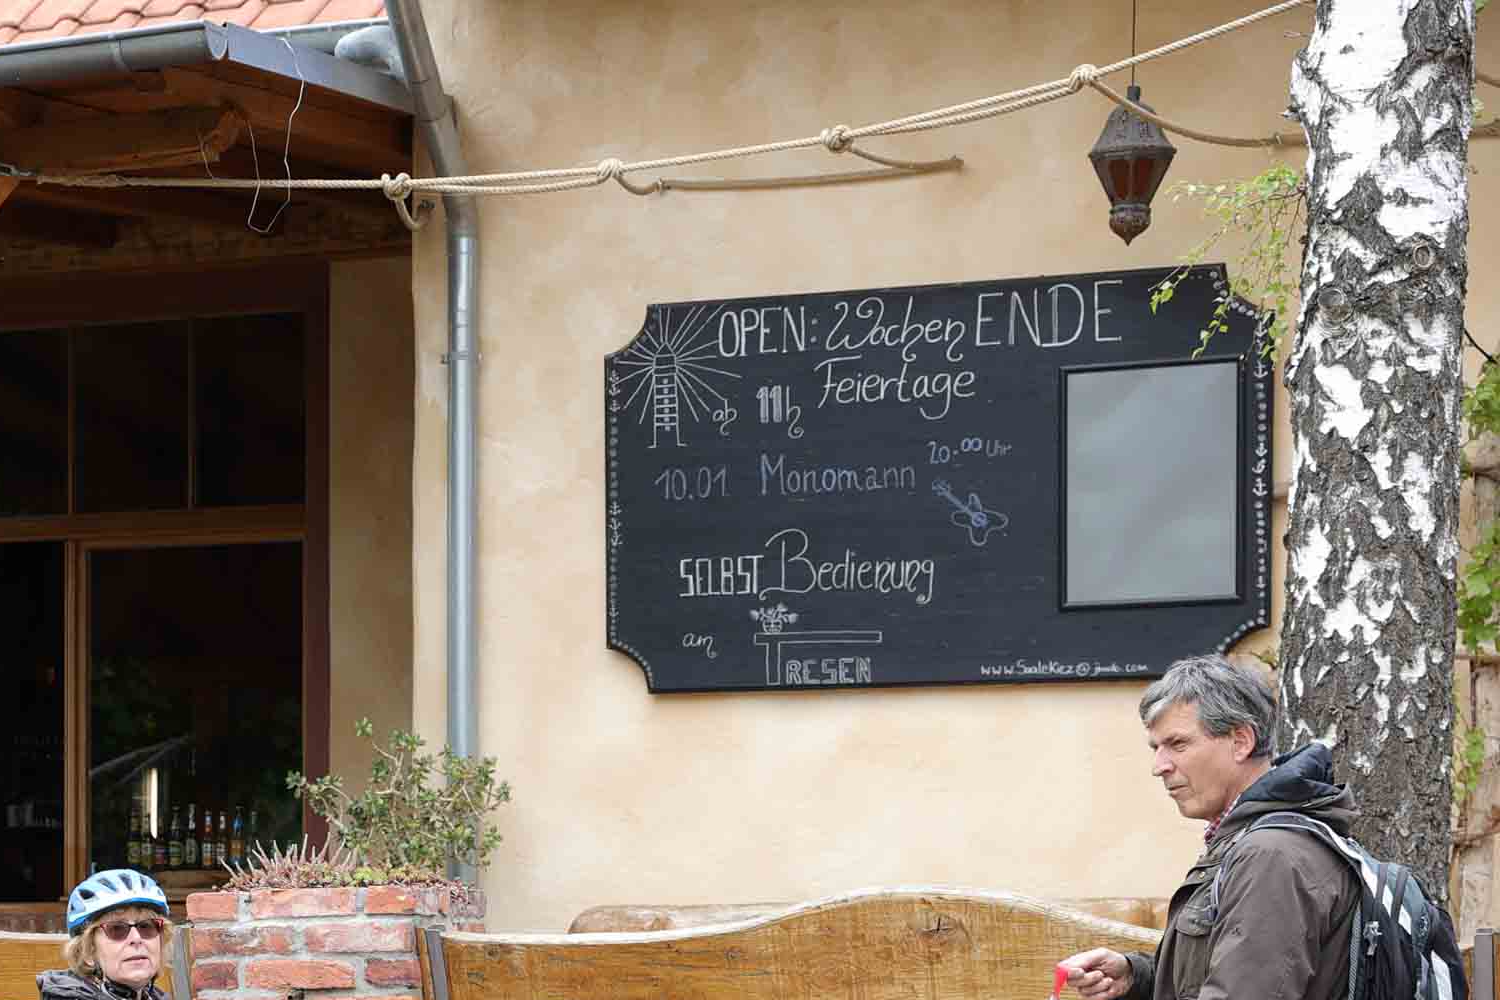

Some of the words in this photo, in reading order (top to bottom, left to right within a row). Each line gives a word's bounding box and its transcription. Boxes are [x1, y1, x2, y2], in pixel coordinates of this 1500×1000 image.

[718, 305, 819, 358] OPEN:
[825, 296, 965, 362] Wochen
[974, 279, 1124, 348] ENDE
[814, 354, 977, 421] Feiertage
[678, 555, 764, 598] SELBST
